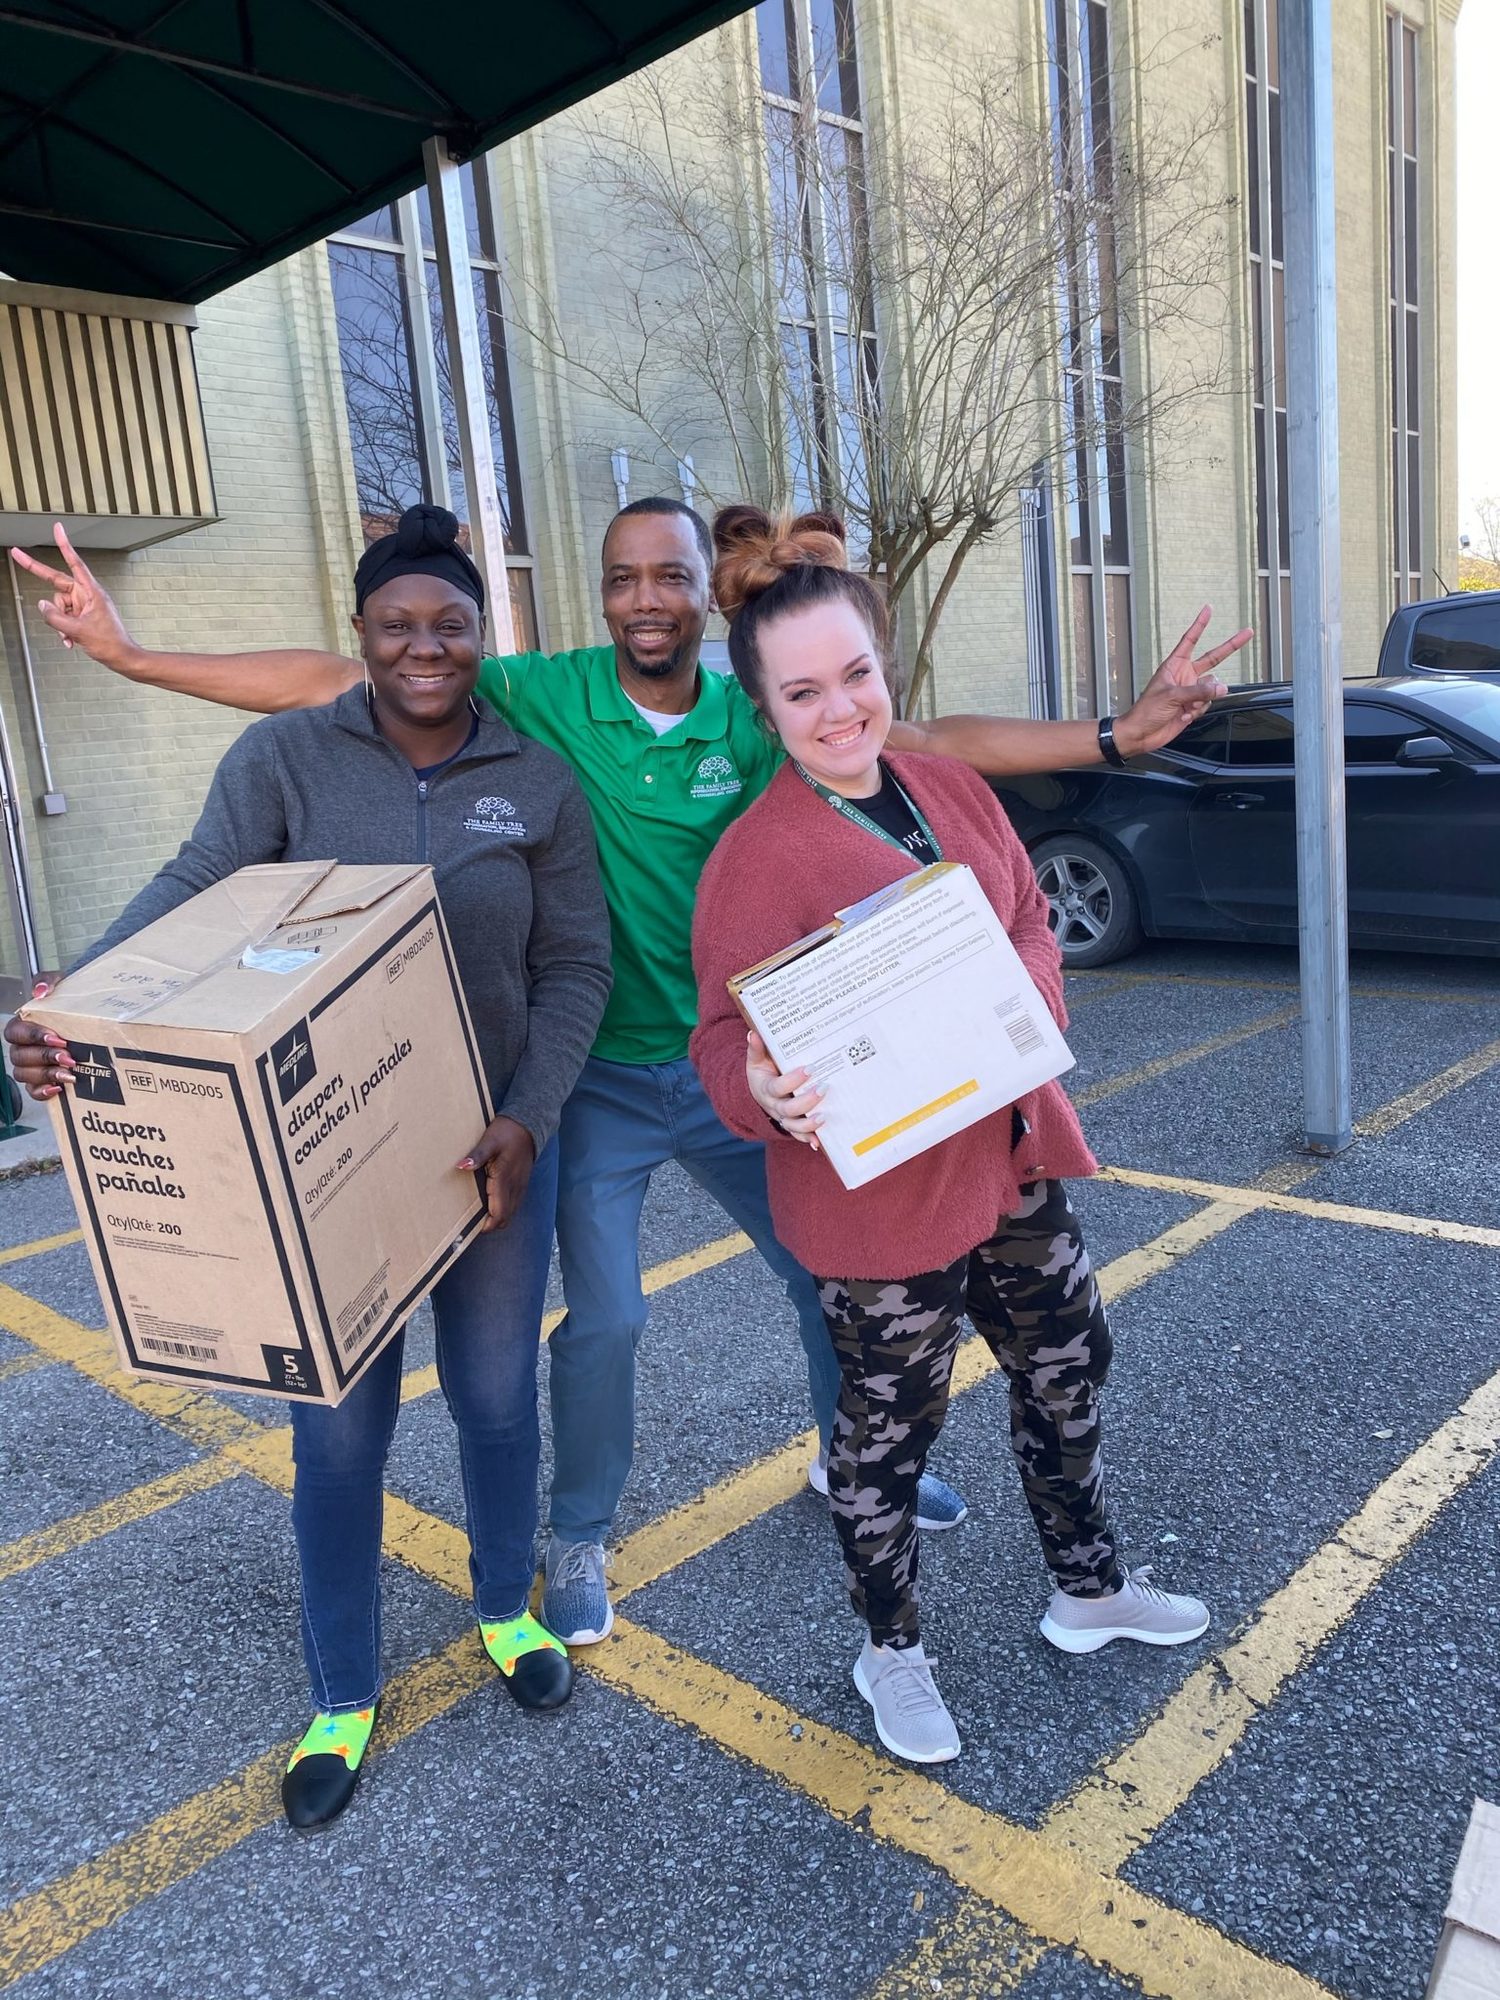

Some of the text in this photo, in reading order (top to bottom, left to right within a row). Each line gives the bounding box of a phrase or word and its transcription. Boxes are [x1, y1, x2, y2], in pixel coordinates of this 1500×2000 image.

[482, 819, 505, 827] FAMILY
[402, 927, 434, 966] MBD2005
[780, 1019, 793, 1030] NOT
[792, 1008, 812, 1023] FLUSH
[834, 983, 858, 999] PLEASE
[866, 971, 880, 982] NOT
[279, 1045, 308, 1078] MEDLINE
[130, 1074, 224, 1100] REF MBD2005
[288, 1074, 344, 1138] diapers
[294, 1101, 351, 1165] couches
[359, 1038, 413, 1107] pañales
[81, 1110, 167, 1145] diapers
[89, 1145, 175, 1171] couches
[337, 1147, 353, 1170] 200
[96, 1171, 187, 1199] pañales
[157, 1222, 183, 1237] 200
[282, 1354, 299, 1374] 5
